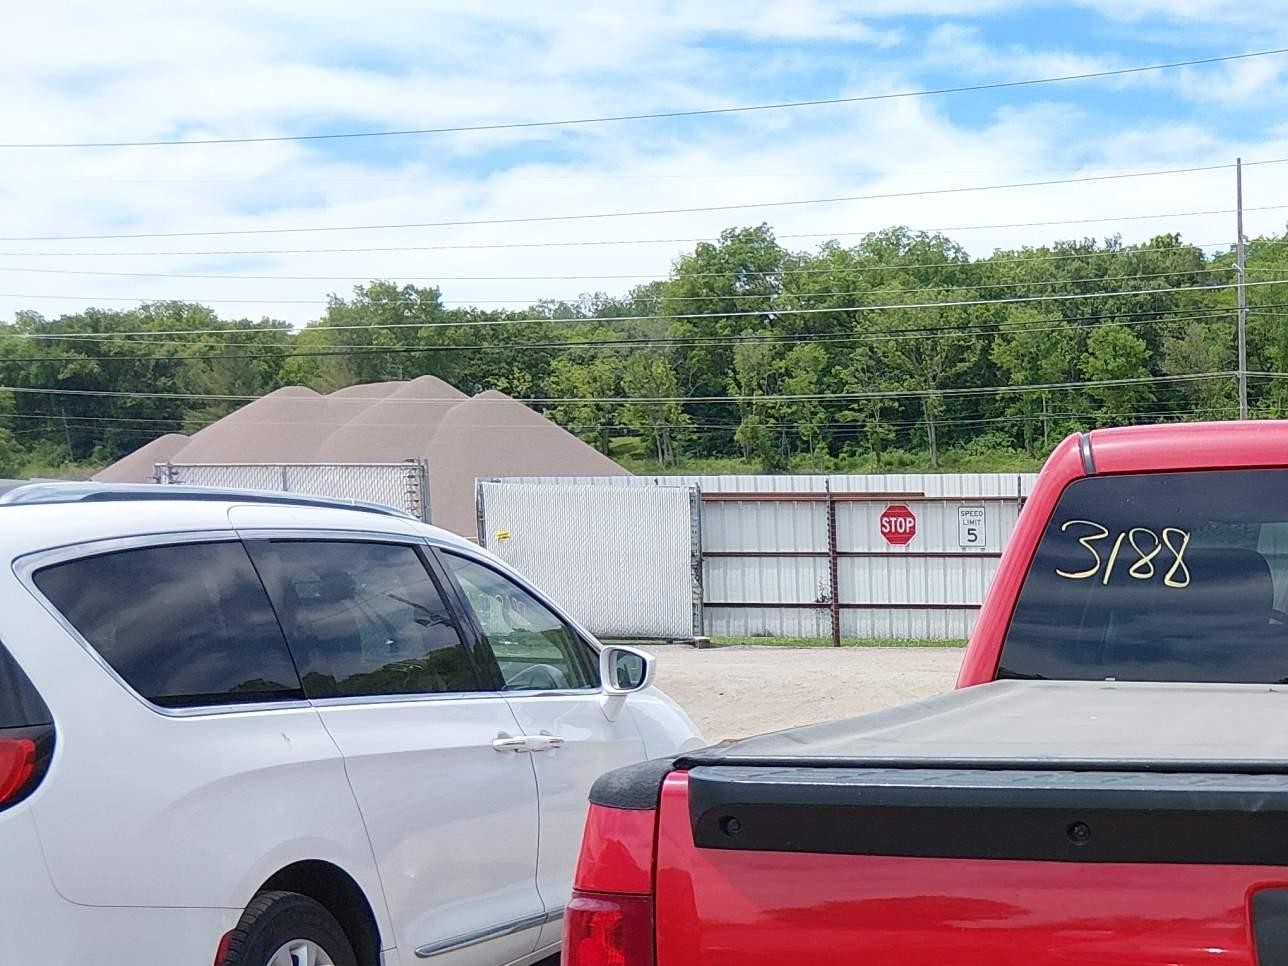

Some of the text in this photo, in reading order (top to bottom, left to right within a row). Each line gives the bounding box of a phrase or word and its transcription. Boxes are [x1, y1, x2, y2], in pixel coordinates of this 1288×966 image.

[881, 517, 915, 533] STOP
[967, 528, 978, 542] 5
[1056, 520, 1191, 588] 3188
